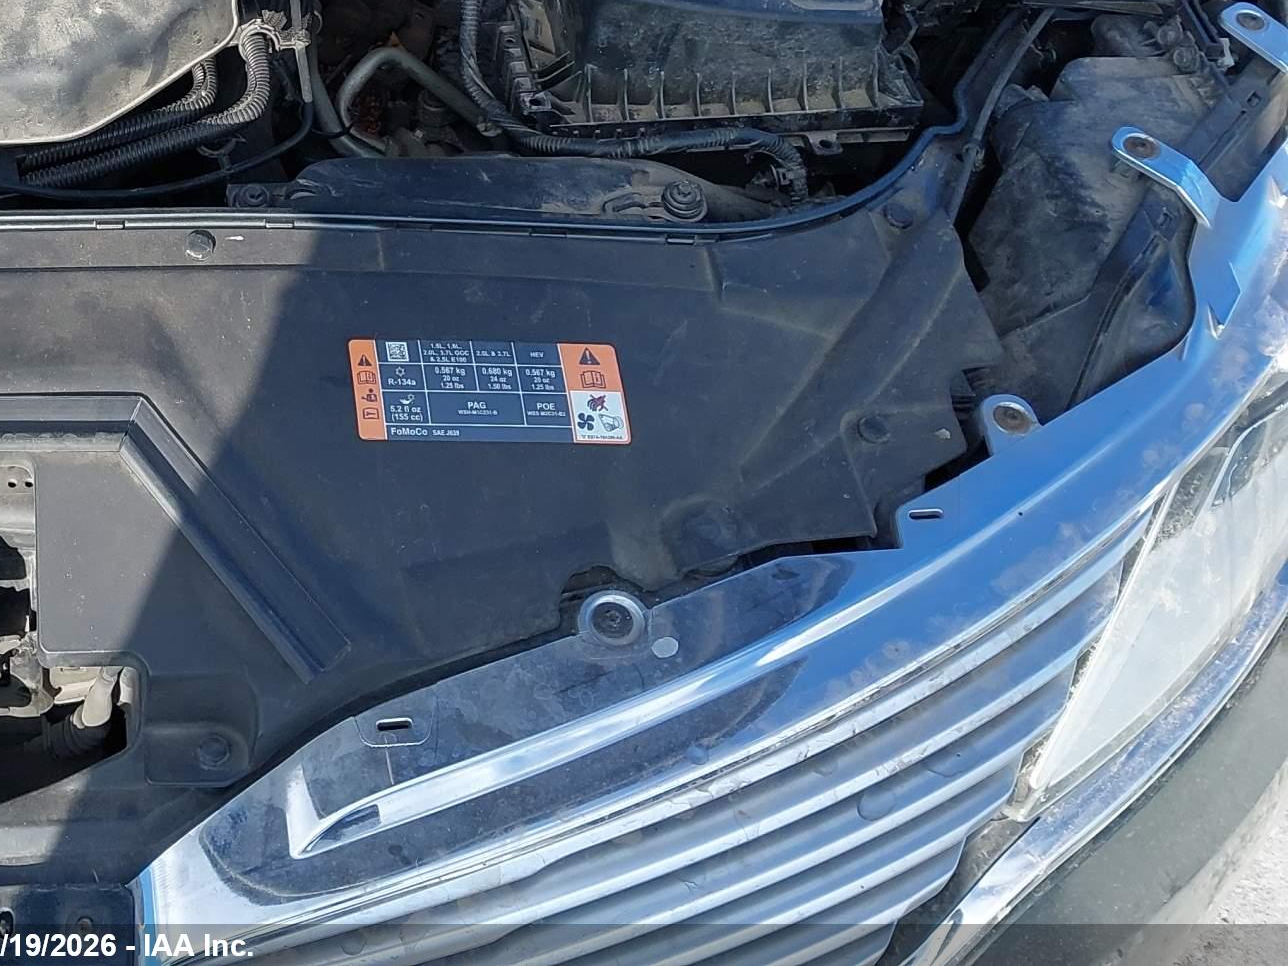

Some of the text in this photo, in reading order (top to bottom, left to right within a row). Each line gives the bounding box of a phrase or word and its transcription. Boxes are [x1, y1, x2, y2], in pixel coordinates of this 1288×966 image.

[434, 366, 466, 376] 0.567 kg
[503, 368, 513, 377] kg
[545, 369, 556, 378] kg
[387, 378, 416, 386] R-134a
[390, 405, 402, 413] 5.2
[467, 401, 487, 409] PAG
[536, 402, 556, 410] POE
[391, 413, 423, 422] (155 cc)
[390, 427, 428, 436] FoMoCo
